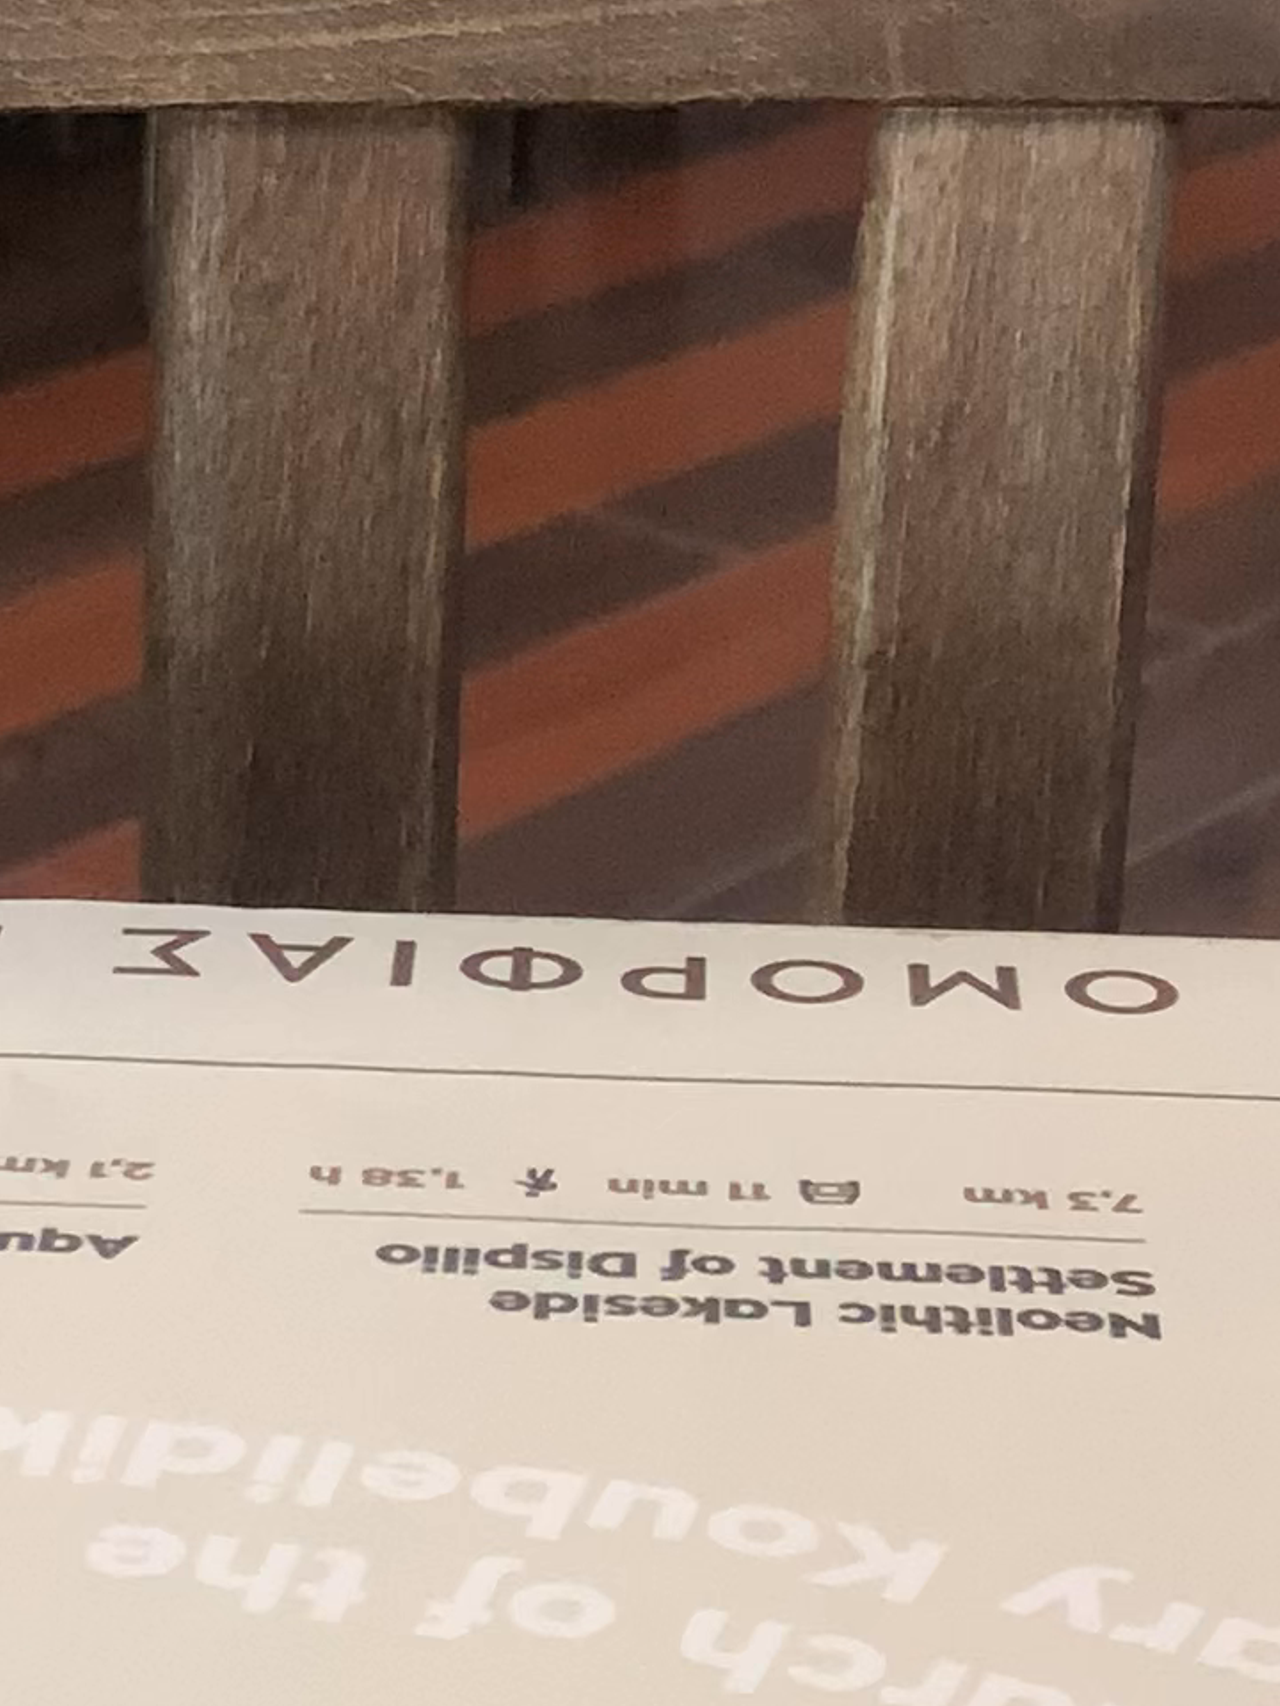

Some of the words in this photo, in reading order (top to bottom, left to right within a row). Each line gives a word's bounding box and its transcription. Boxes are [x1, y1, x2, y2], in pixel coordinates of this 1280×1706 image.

[111, 927, 1180, 1016] ΟΜΟΡΦΙΑΣ
[308, 1164, 343, 1187] h
[607, 1177, 709, 1201] min
[962, 1186, 1050, 1211] km
[373, 1242, 639, 1281] Dispilio
[658, 1247, 738, 1282] of
[757, 1255, 1157, 1299] Settlement
[486, 1288, 814, 1330] Lakeside
[836, 1300, 1164, 1342] Neolithic
[85, 1522, 368, 1623] the
[413, 1555, 617, 1641] of
